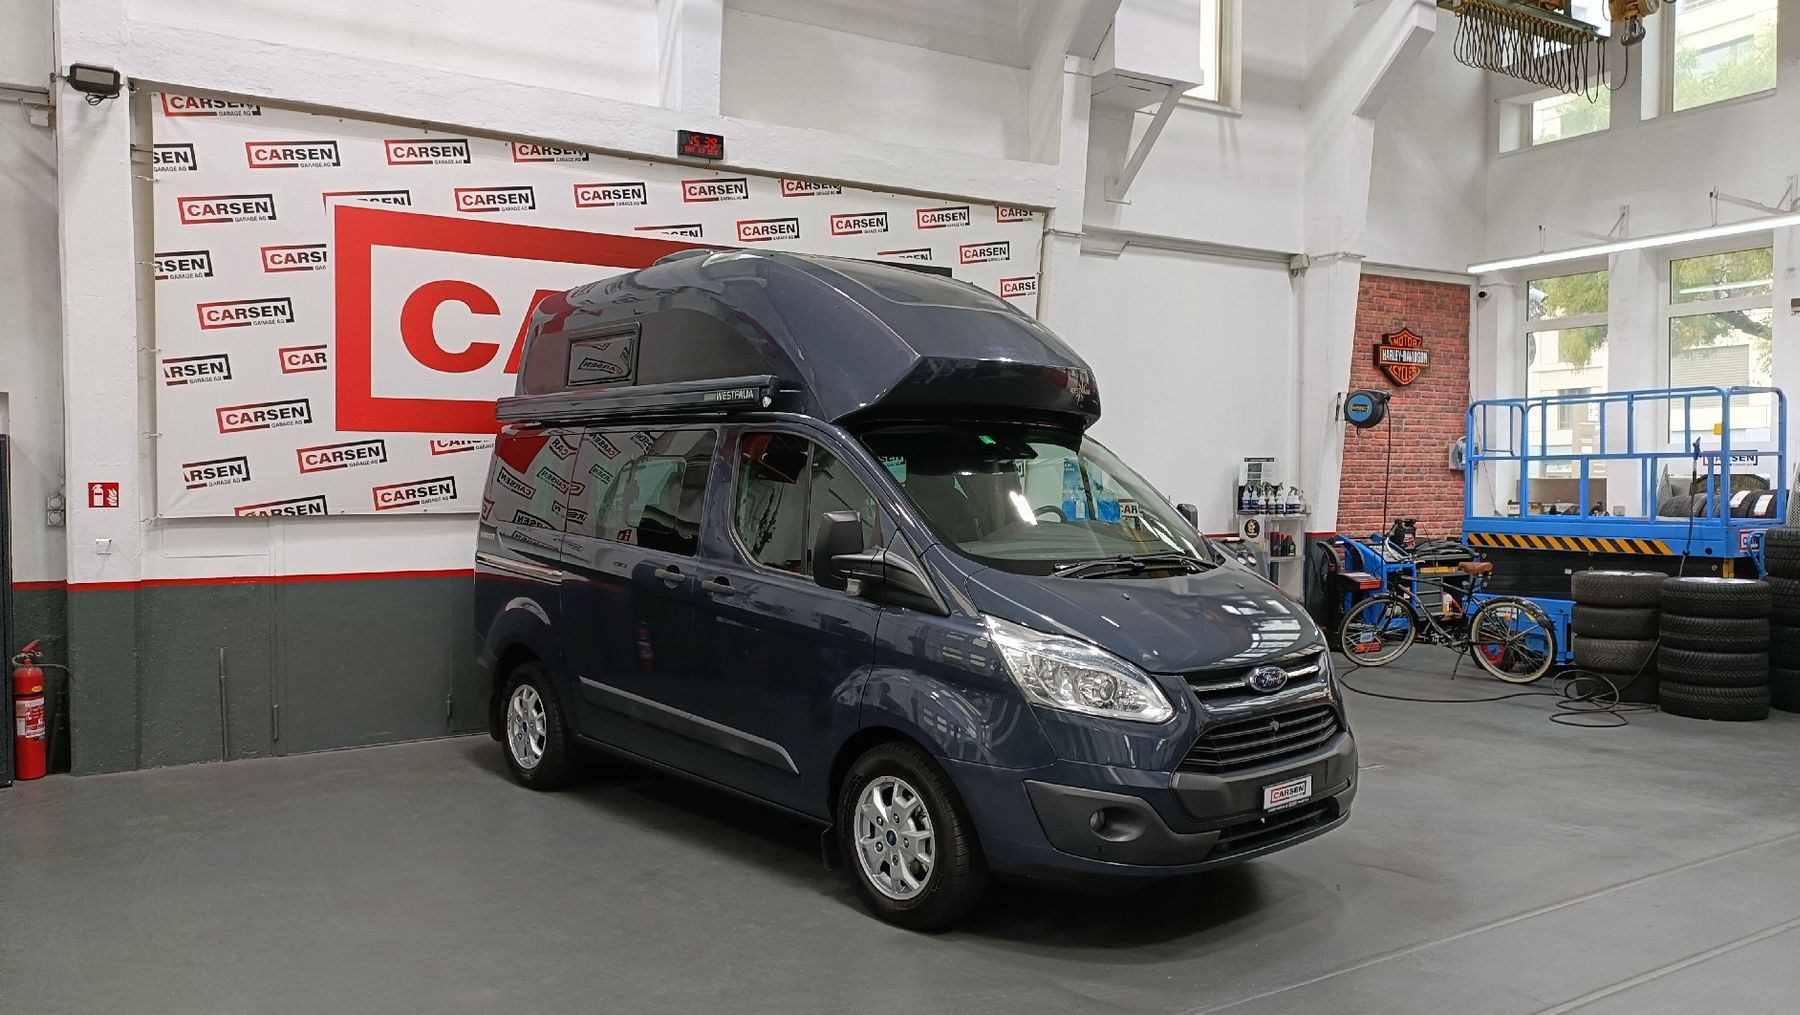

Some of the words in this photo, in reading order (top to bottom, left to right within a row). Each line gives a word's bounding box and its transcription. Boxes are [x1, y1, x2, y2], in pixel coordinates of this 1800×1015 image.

[254, 148, 332, 160] CARSEN
[394, 146, 464, 158] CARSEN
[580, 188, 642, 201] CARSEN
[688, 184, 744, 197] CARSEN
[462, 192, 529, 206] CARSEN
[187, 202, 269, 216] CARSEN
[836, 218, 884, 230] CARSEN
[921, 212, 966, 223] CARSEN
[742, 224, 796, 237] CARSEN
[964, 247, 1007, 259] CARSEN
[207, 304, 286, 322] CARSEN
[1394, 336, 1418, 347] MOTOR
[1382, 349, 1428, 364] HARLEY-DAVIDSON
[1392, 366, 1416, 382] CYCLES
[716, 390, 754, 400] WESTFALIA
[226, 406, 304, 425] CARSEN
[305, 446, 380, 466] CARSEN
[380, 484, 450, 503] CARSEN
[1274, 786, 1304, 799] CARSEN
